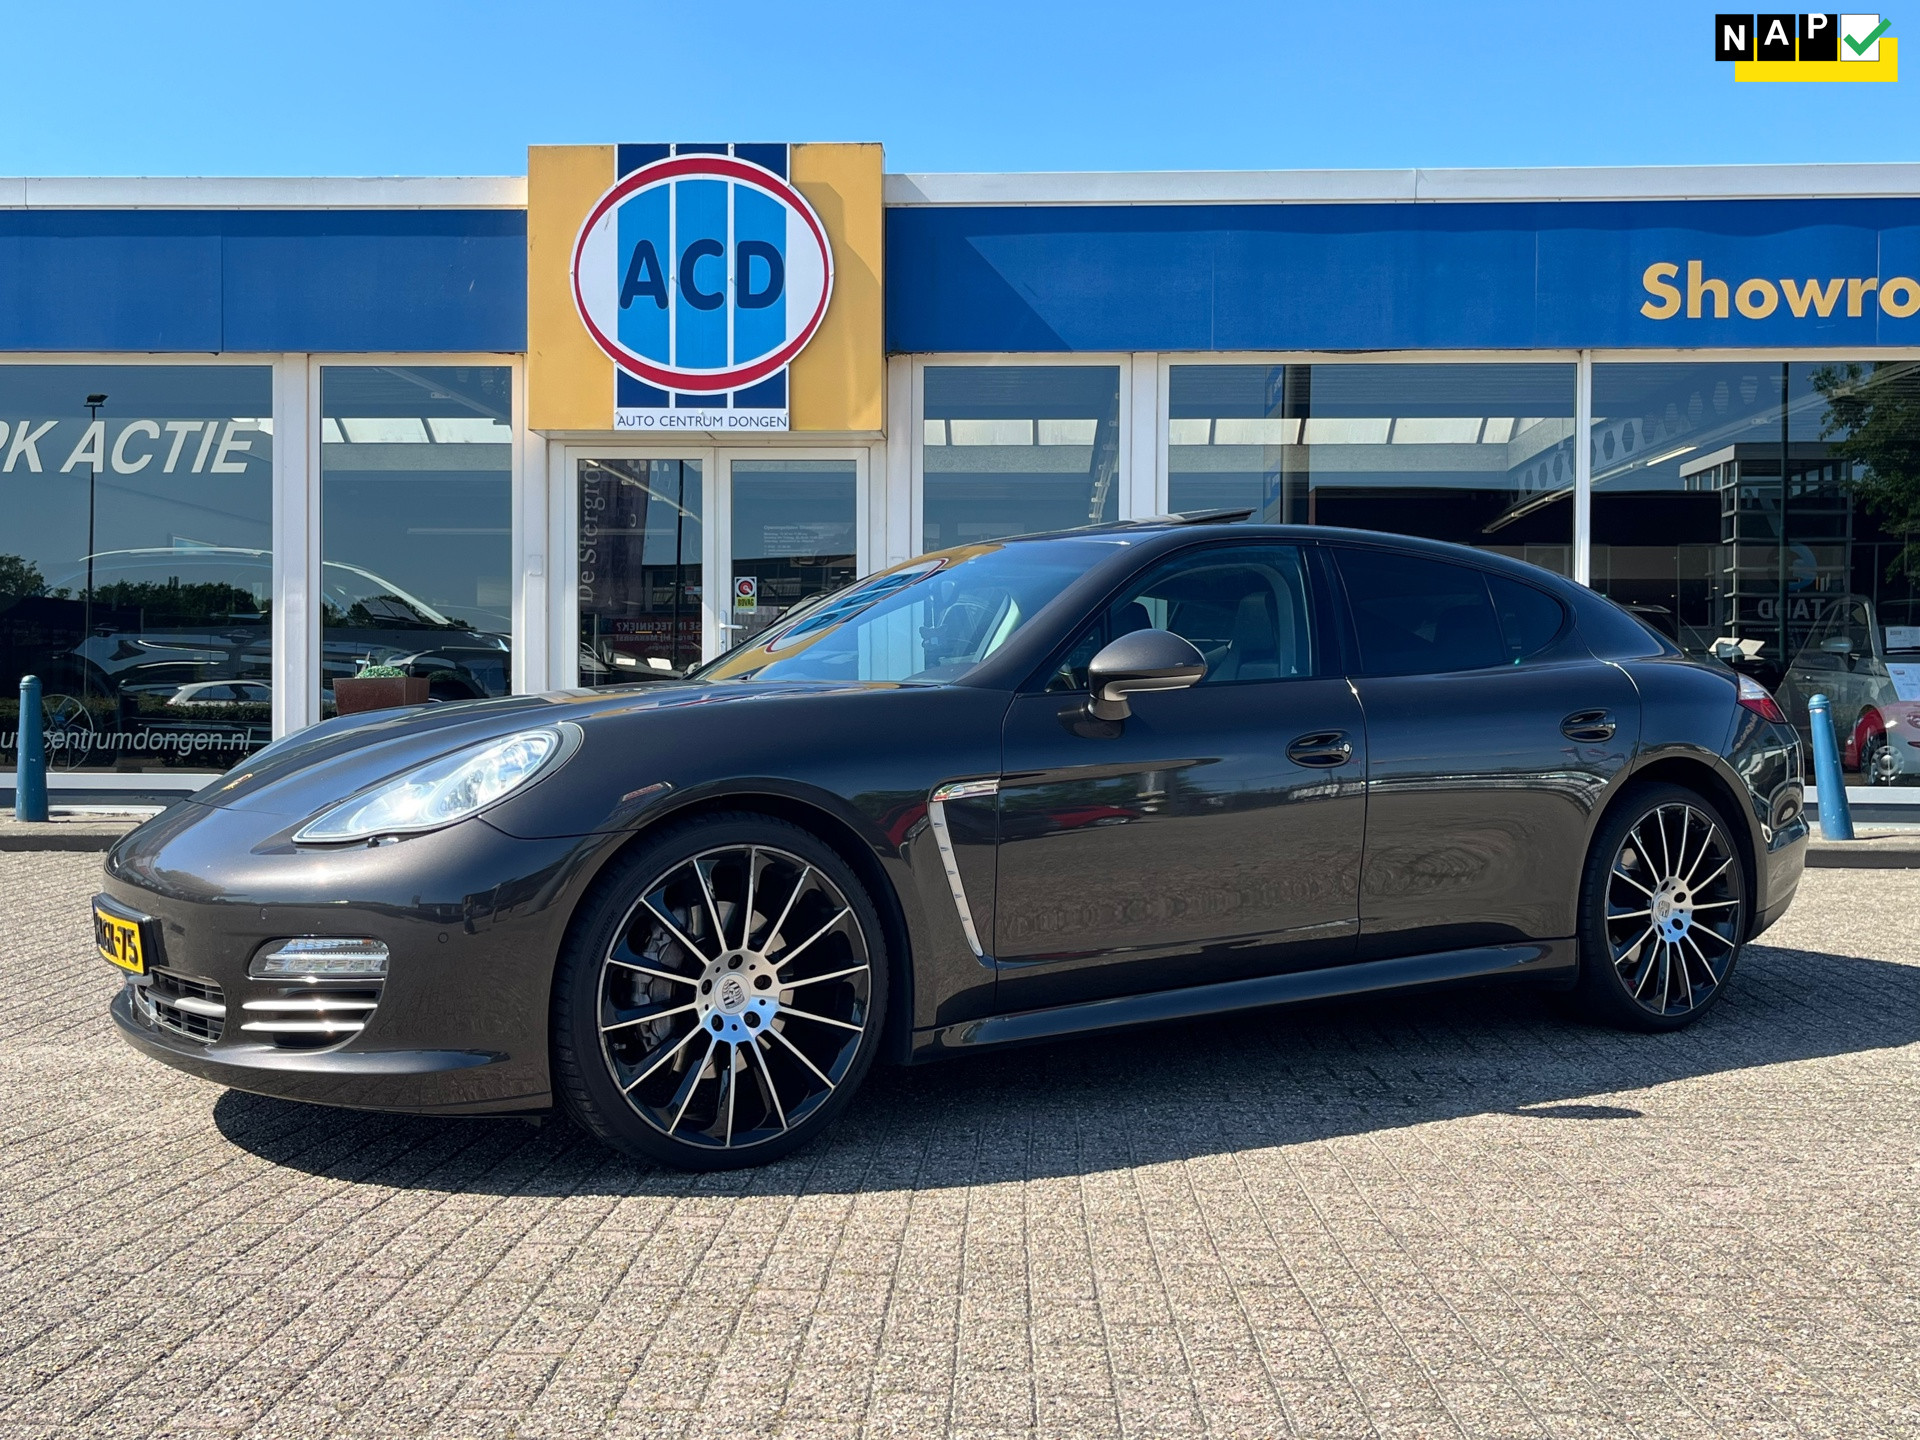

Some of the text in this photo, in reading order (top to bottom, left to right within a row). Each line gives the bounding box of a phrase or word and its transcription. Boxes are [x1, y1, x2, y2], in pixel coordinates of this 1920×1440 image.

[619, 238, 785, 311] ACD
[1640, 260, 1920, 320] Showro
[59, 419, 262, 474] ACTIE
[617, 416, 787, 427] AUTO CENTRUM DONGEN
